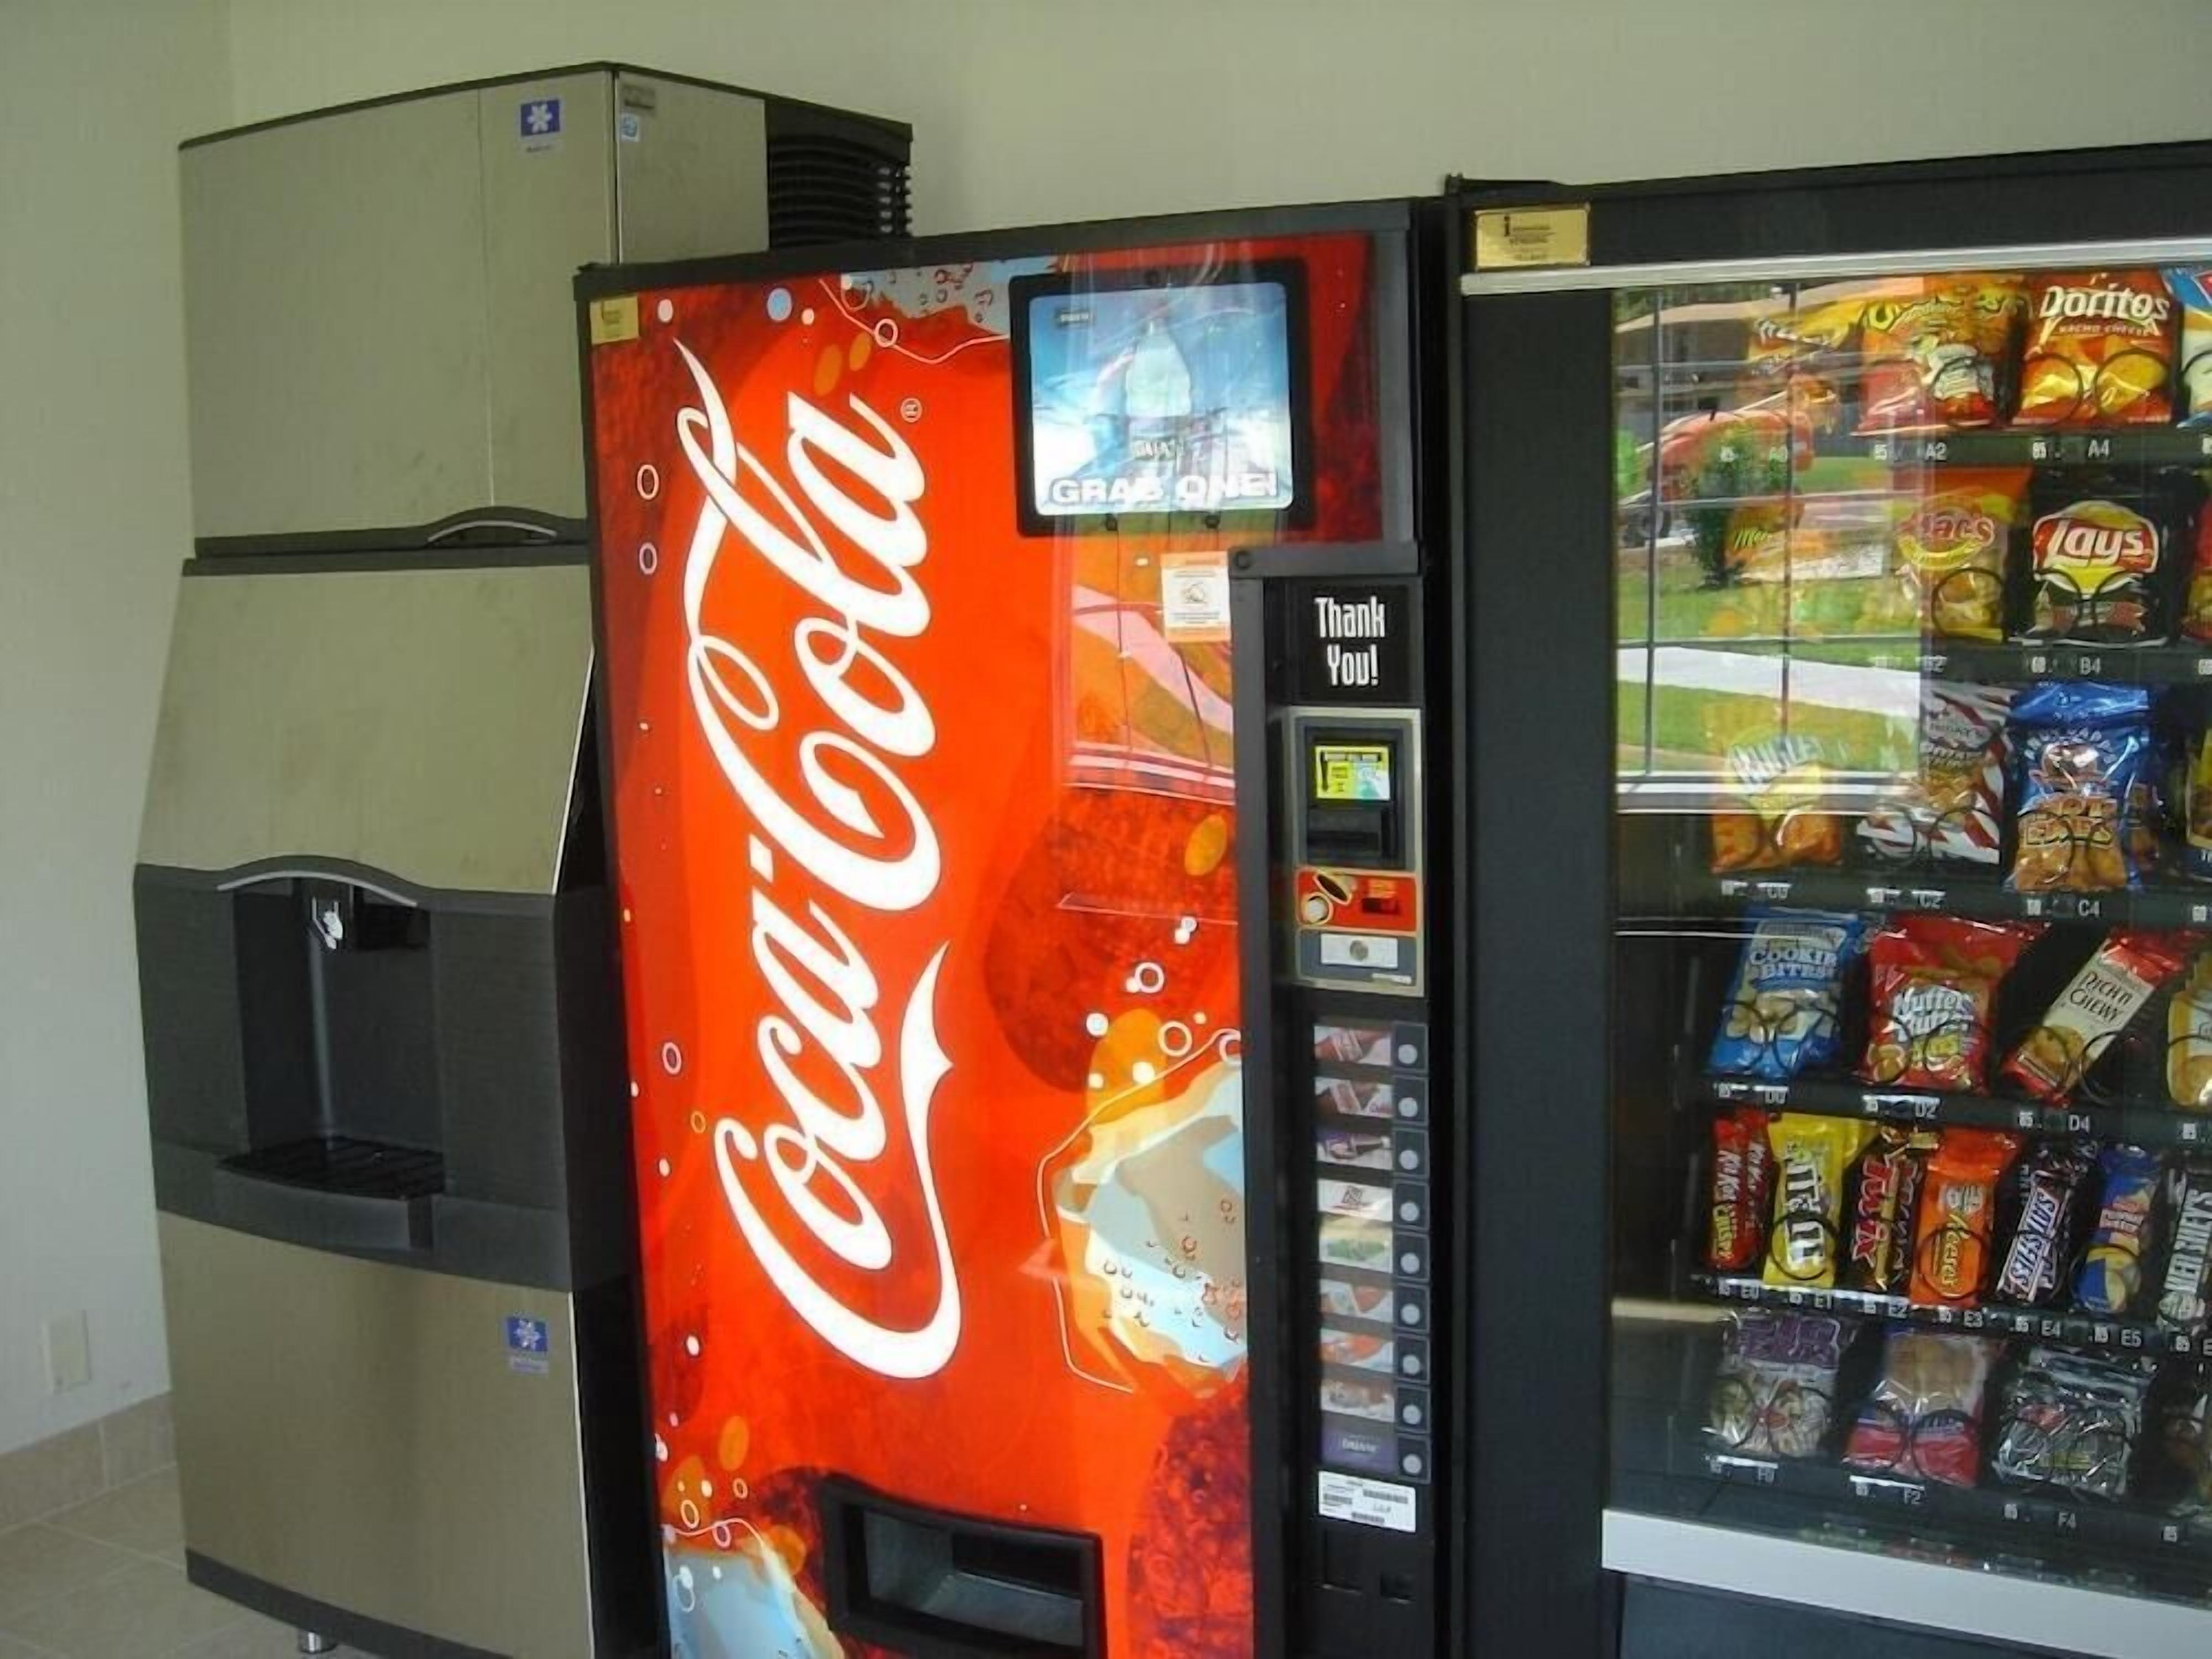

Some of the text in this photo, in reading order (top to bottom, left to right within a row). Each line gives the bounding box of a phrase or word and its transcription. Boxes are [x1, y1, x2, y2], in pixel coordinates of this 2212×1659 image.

[2039, 283, 2171, 321] Doritos
[1924, 443, 1947, 462] A2
[2087, 440, 2110, 458] A4
[1314, 596, 1386, 638] Thank
[1326, 644, 1379, 686] You!
[2078, 900, 2100, 917] C4
[2068, 1115, 2090, 1131] D4
[2041, 1319, 2061, 1337] E4
[2058, 1512, 2077, 1528] F4
